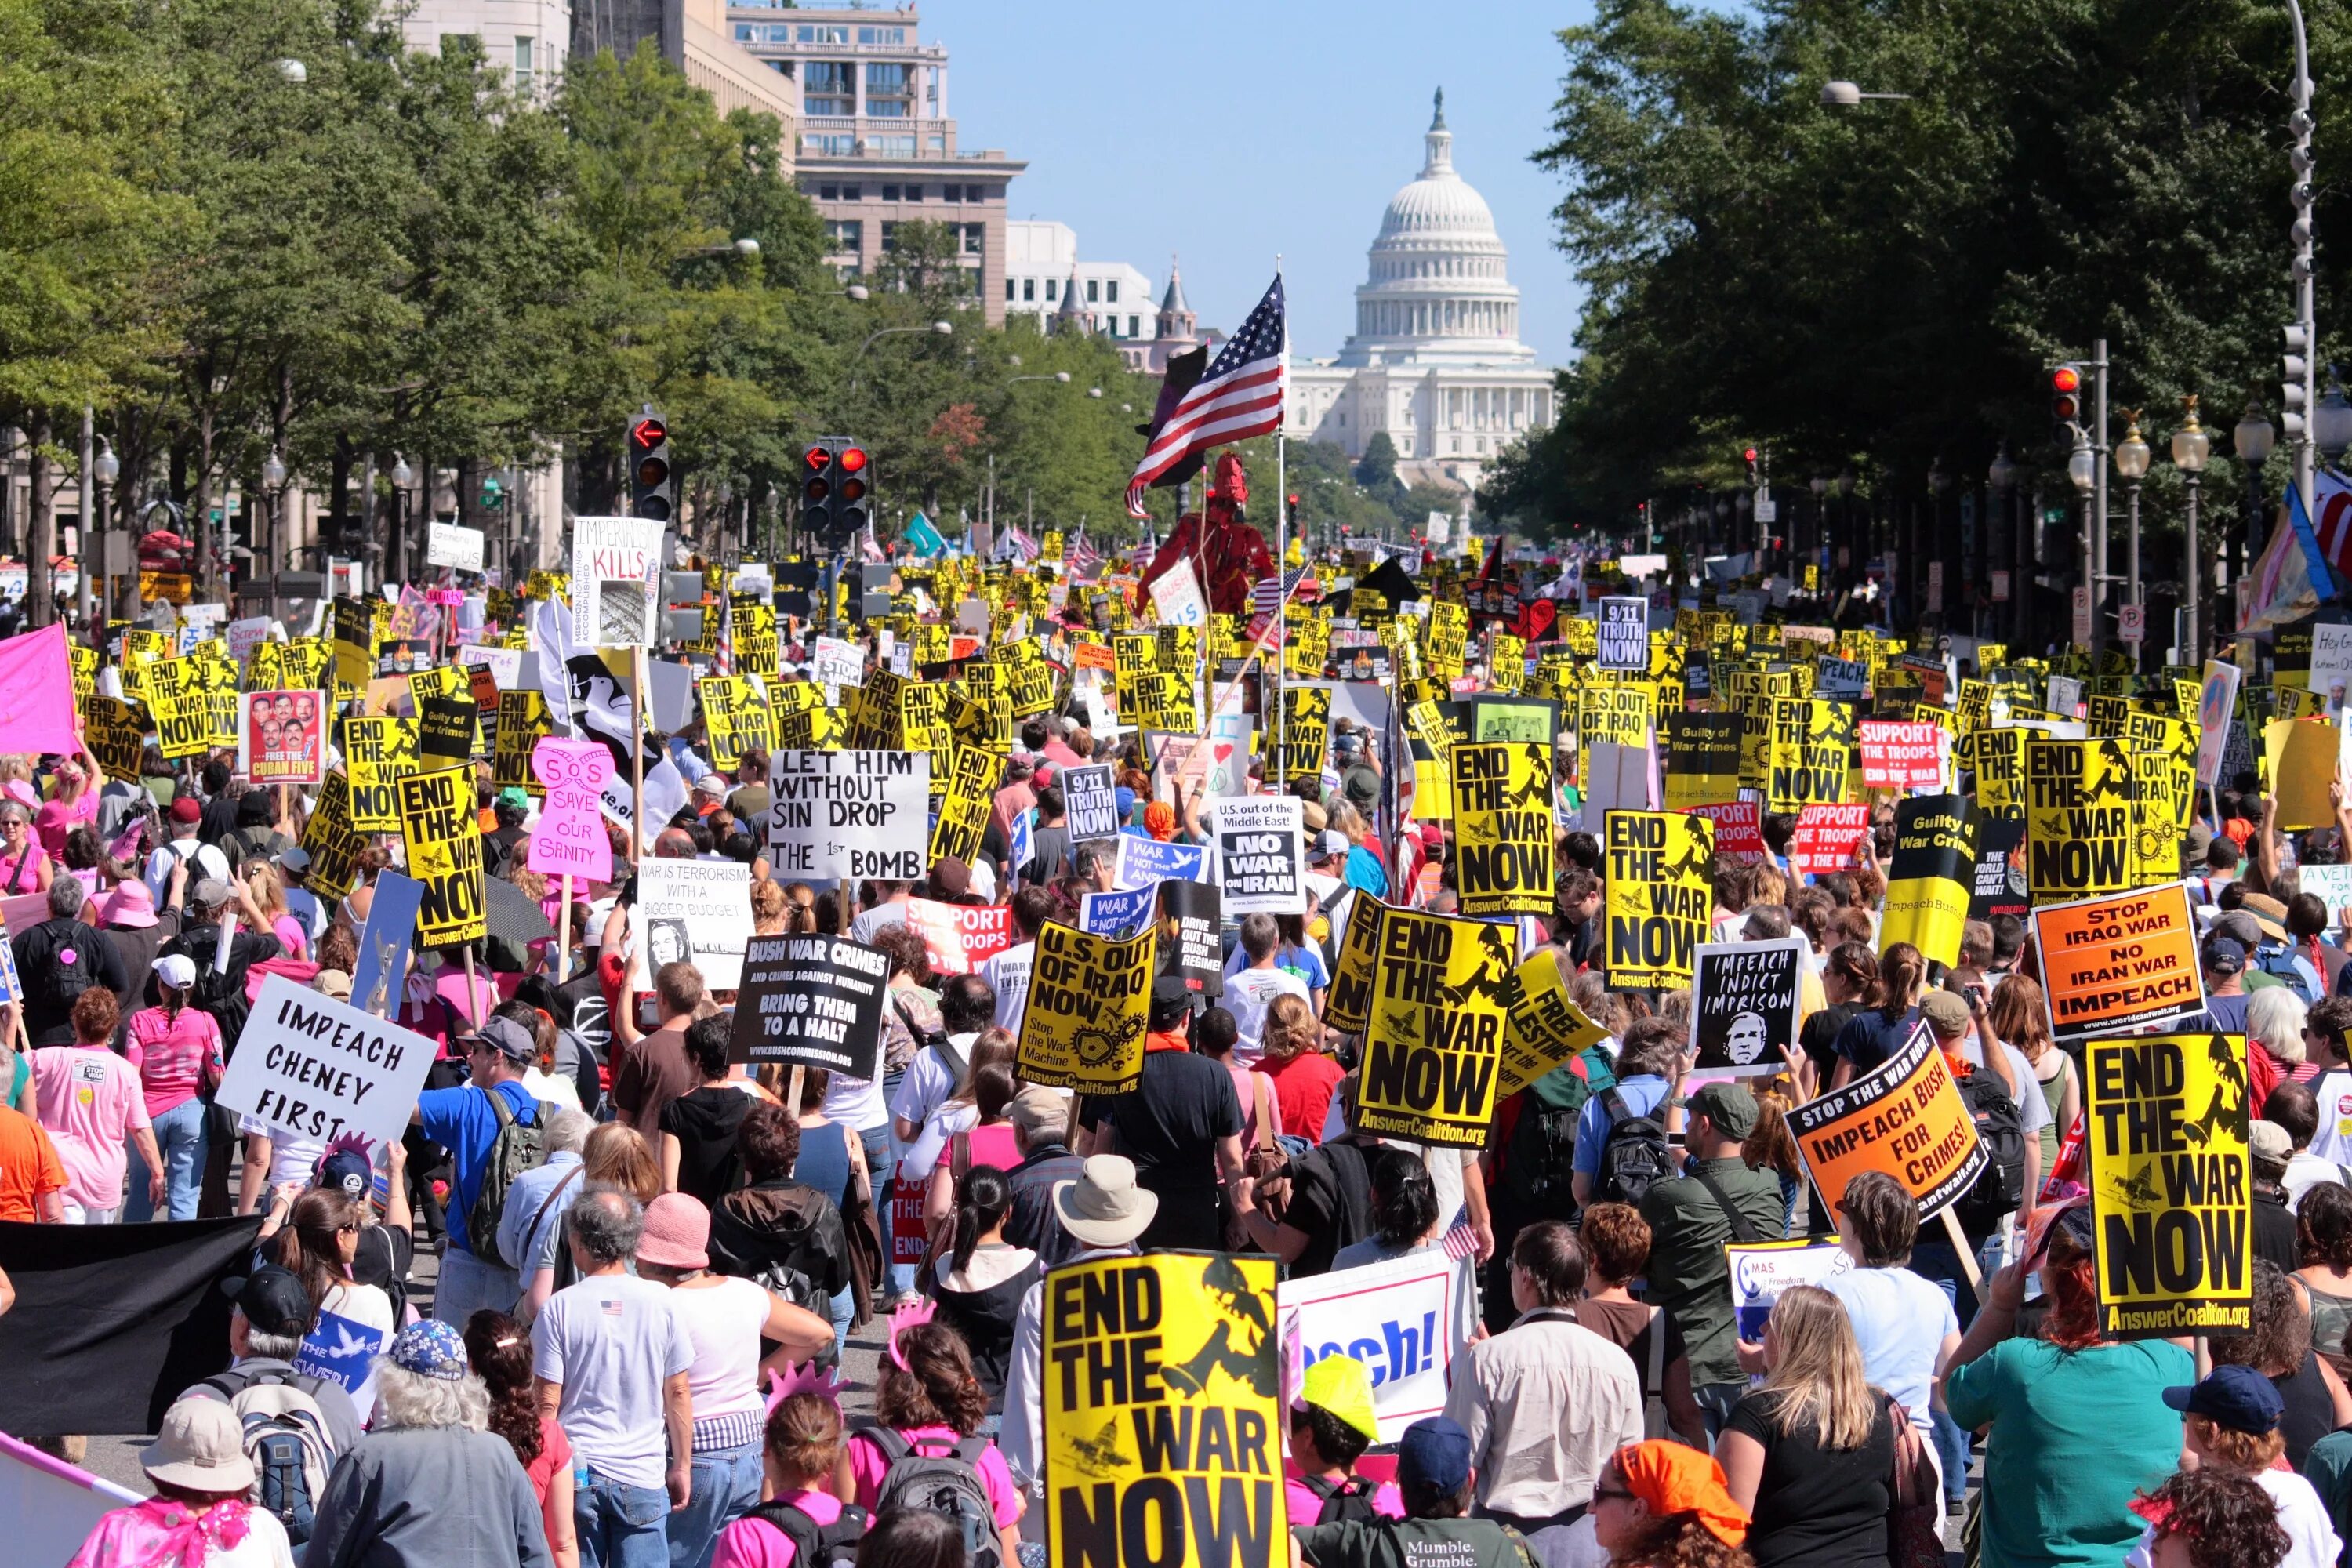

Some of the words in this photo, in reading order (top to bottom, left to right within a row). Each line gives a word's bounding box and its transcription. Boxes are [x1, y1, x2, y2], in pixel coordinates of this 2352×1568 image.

[576, 520, 655, 551] IMPERIALISM
[593, 548, 644, 579] KILLS
[429, 590, 463, 605] unity
[1608, 606, 1639, 622] 9/11
[1602, 621, 1643, 641] TRUTH
[1602, 640, 1642, 663] NOW
[151, 661, 179, 682] END
[151, 680, 180, 699] THE
[175, 695, 204, 716] WAR
[428, 710, 451, 725] Guilty
[452, 714, 466, 725] of
[159, 714, 206, 746] NOW
[421, 723, 438, 733] War
[438, 724, 470, 739] Crimes
[1681, 727, 1716, 740] Guilty
[1718, 726, 1730, 738] of
[1862, 725, 1934, 743] SUPPORT
[266, 751, 285, 761] FREE
[285, 751, 303, 761] THE
[1672, 741, 1696, 753] War
[1697, 741, 1737, 753] Crimes
[1864, 745, 1884, 759] THE
[1887, 746, 1936, 760] TROOPS
[2031, 745, 2084, 777] END
[252, 761, 288, 775] CUBAN
[292, 761, 314, 775] FIVE
[784, 751, 837, 774] LET
[1456, 747, 1510, 780] END
[1865, 768, 1885, 782] END
[1887, 768, 1907, 782] THE
[1911, 767, 1938, 781] WAR
[772, 775, 889, 801] WITHOUT
[1073, 772, 1105, 793] 9/11
[1457, 779, 1511, 812] THE
[2032, 777, 2085, 809] THE
[553, 790, 596, 813] SAVE
[772, 800, 812, 829] SIN
[829, 800, 896, 827] DROP
[1068, 789, 1113, 812] TRUTH
[1219, 805, 1239, 815] U.S.
[1240, 804, 1258, 815] out
[1260, 803, 1272, 814] of
[1276, 803, 1293, 814] the
[557, 822, 592, 841] OUR
[1070, 808, 1114, 837] NOW
[1223, 815, 1262, 827] Middle
[1264, 815, 1290, 826] East!
[1495, 812, 1548, 844] WAR
[1610, 815, 1667, 848] END
[1913, 815, 1962, 833] Guilty
[1964, 823, 1974, 838] of
[2067, 807, 2127, 840] WAR
[538, 837, 595, 866] SANITY
[1236, 833, 1282, 855] NO
[1900, 836, 1929, 850] War
[1933, 833, 1976, 862] Crimes
[1986, 851, 2005, 862] THE
[641, 865, 662, 879] WAR
[664, 865, 673, 879] IS
[677, 866, 746, 882] TERRORISM
[771, 842, 815, 871] THE
[826, 840, 846, 856] 1ST
[851, 849, 920, 879] BOMB
[1229, 855, 1289, 876] WAR
[1461, 843, 1550, 894] NOW
[1610, 849, 1666, 882] THE
[2032, 838, 2128, 888] NOW
[666, 884, 696, 898] WITH
[699, 884, 708, 898] A
[1225, 879, 1242, 889] ON
[1242, 875, 1294, 893] IRAN
[1974, 885, 2004, 896] WAIT!
[1975, 873, 2005, 885] CAN'T
[644, 902, 686, 916] BIGGER
[688, 903, 740, 916] BUDGET
[1463, 895, 1554, 915] AnswerCoalition.org
[1649, 883, 1708, 922] WAR
[2087, 901, 2150, 925] STOP
[1181, 916, 1210, 932] DRIVE
[1181, 928, 1202, 943] OUT
[1203, 933, 1219, 947] THE
[2065, 924, 2122, 946] IRAQ
[2125, 914, 2171, 936] WAR
[1043, 927, 1097, 964] U.S.
[1102, 931, 1154, 971] OUT
[1181, 942, 1208, 957] BUSH
[1385, 916, 1453, 965] END
[1611, 915, 1707, 967] NOW
[2110, 944, 2143, 963] NO
[748, 940, 787, 964] BUSH
[789, 939, 827, 962] WAR
[829, 942, 887, 978] CRIMES
[1181, 953, 1221, 972] REGIME!
[1714, 949, 1789, 977] IMPEACH
[2071, 966, 2129, 986] IRAN
[2133, 954, 2177, 975] WAR
[750, 971, 767, 983] AND
[768, 970, 794, 982] CRIMES
[794, 971, 834, 985] AGAINST
[834, 975, 875, 996] HUMANITY
[1039, 954, 1079, 987] OF
[1082, 965, 1146, 1000] IRAQ
[1382, 956, 1449, 1007] THE
[1719, 971, 1782, 994] INDICT
[759, 993, 808, 1014] BRING
[813, 994, 857, 1025] THEM
[1033, 981, 1102, 1025] NOW
[1704, 986, 1792, 1016] IMPRISON
[2058, 975, 2193, 1017] IMPEACH
[764, 1016, 783, 1036] TO
[786, 1016, 799, 1036] A
[804, 1016, 848, 1044] HALT
[1029, 1017, 1054, 1036] Stop
[1423, 1005, 1498, 1054] WAR
[2083, 1004, 2181, 1030] www.worldcantwait.org
[277, 999, 405, 1072] IMPEACH
[1027, 1033, 1044, 1047] the
[1047, 1036, 1068, 1053] War
[750, 1046, 853, 1068] WWW.BUSHCOMMISSION.ORG
[1024, 1047, 1069, 1067] Machine
[265, 1044, 375, 1105] CHENEY
[1018, 1064, 1138, 1096] AnswerCoalition.org
[1365, 1040, 1497, 1116] NOW
[1801, 1098, 1845, 1127] STOP
[1849, 1078, 1884, 1105] THE
[1883, 1058, 1912, 1087] WAR
[1910, 1032, 1930, 1069] NOW!
[2093, 1042, 2185, 1101] END
[256, 1088, 346, 1143] FIRST
[1358, 1108, 1487, 1145] AnswerCoalition.org
[1811, 1098, 1916, 1165] IMPEACH
[1913, 1061, 1946, 1111] BUSH
[2095, 1098, 2187, 1156] THE
[1890, 1122, 1932, 1162] FOR
[1905, 1116, 1969, 1186] CRIMES!
[2160, 1154, 2245, 1208] WAR
[2104, 1208, 2246, 1298] NOW
[1751, 1262, 1775, 1274] MAS
[1769, 1276, 1806, 1286] Freedom
[1053, 1265, 1163, 1343] END
[2107, 1300, 2251, 1332] AnswerCoalition.org
[1051, 1334, 1165, 1412] THE
[1131, 1405, 1272, 1475] WAR
[1059, 1475, 1274, 1568] NOW
[1406, 1555, 1478, 1568] Grumble.
[1407, 1541, 1475, 1555] Mumble.
